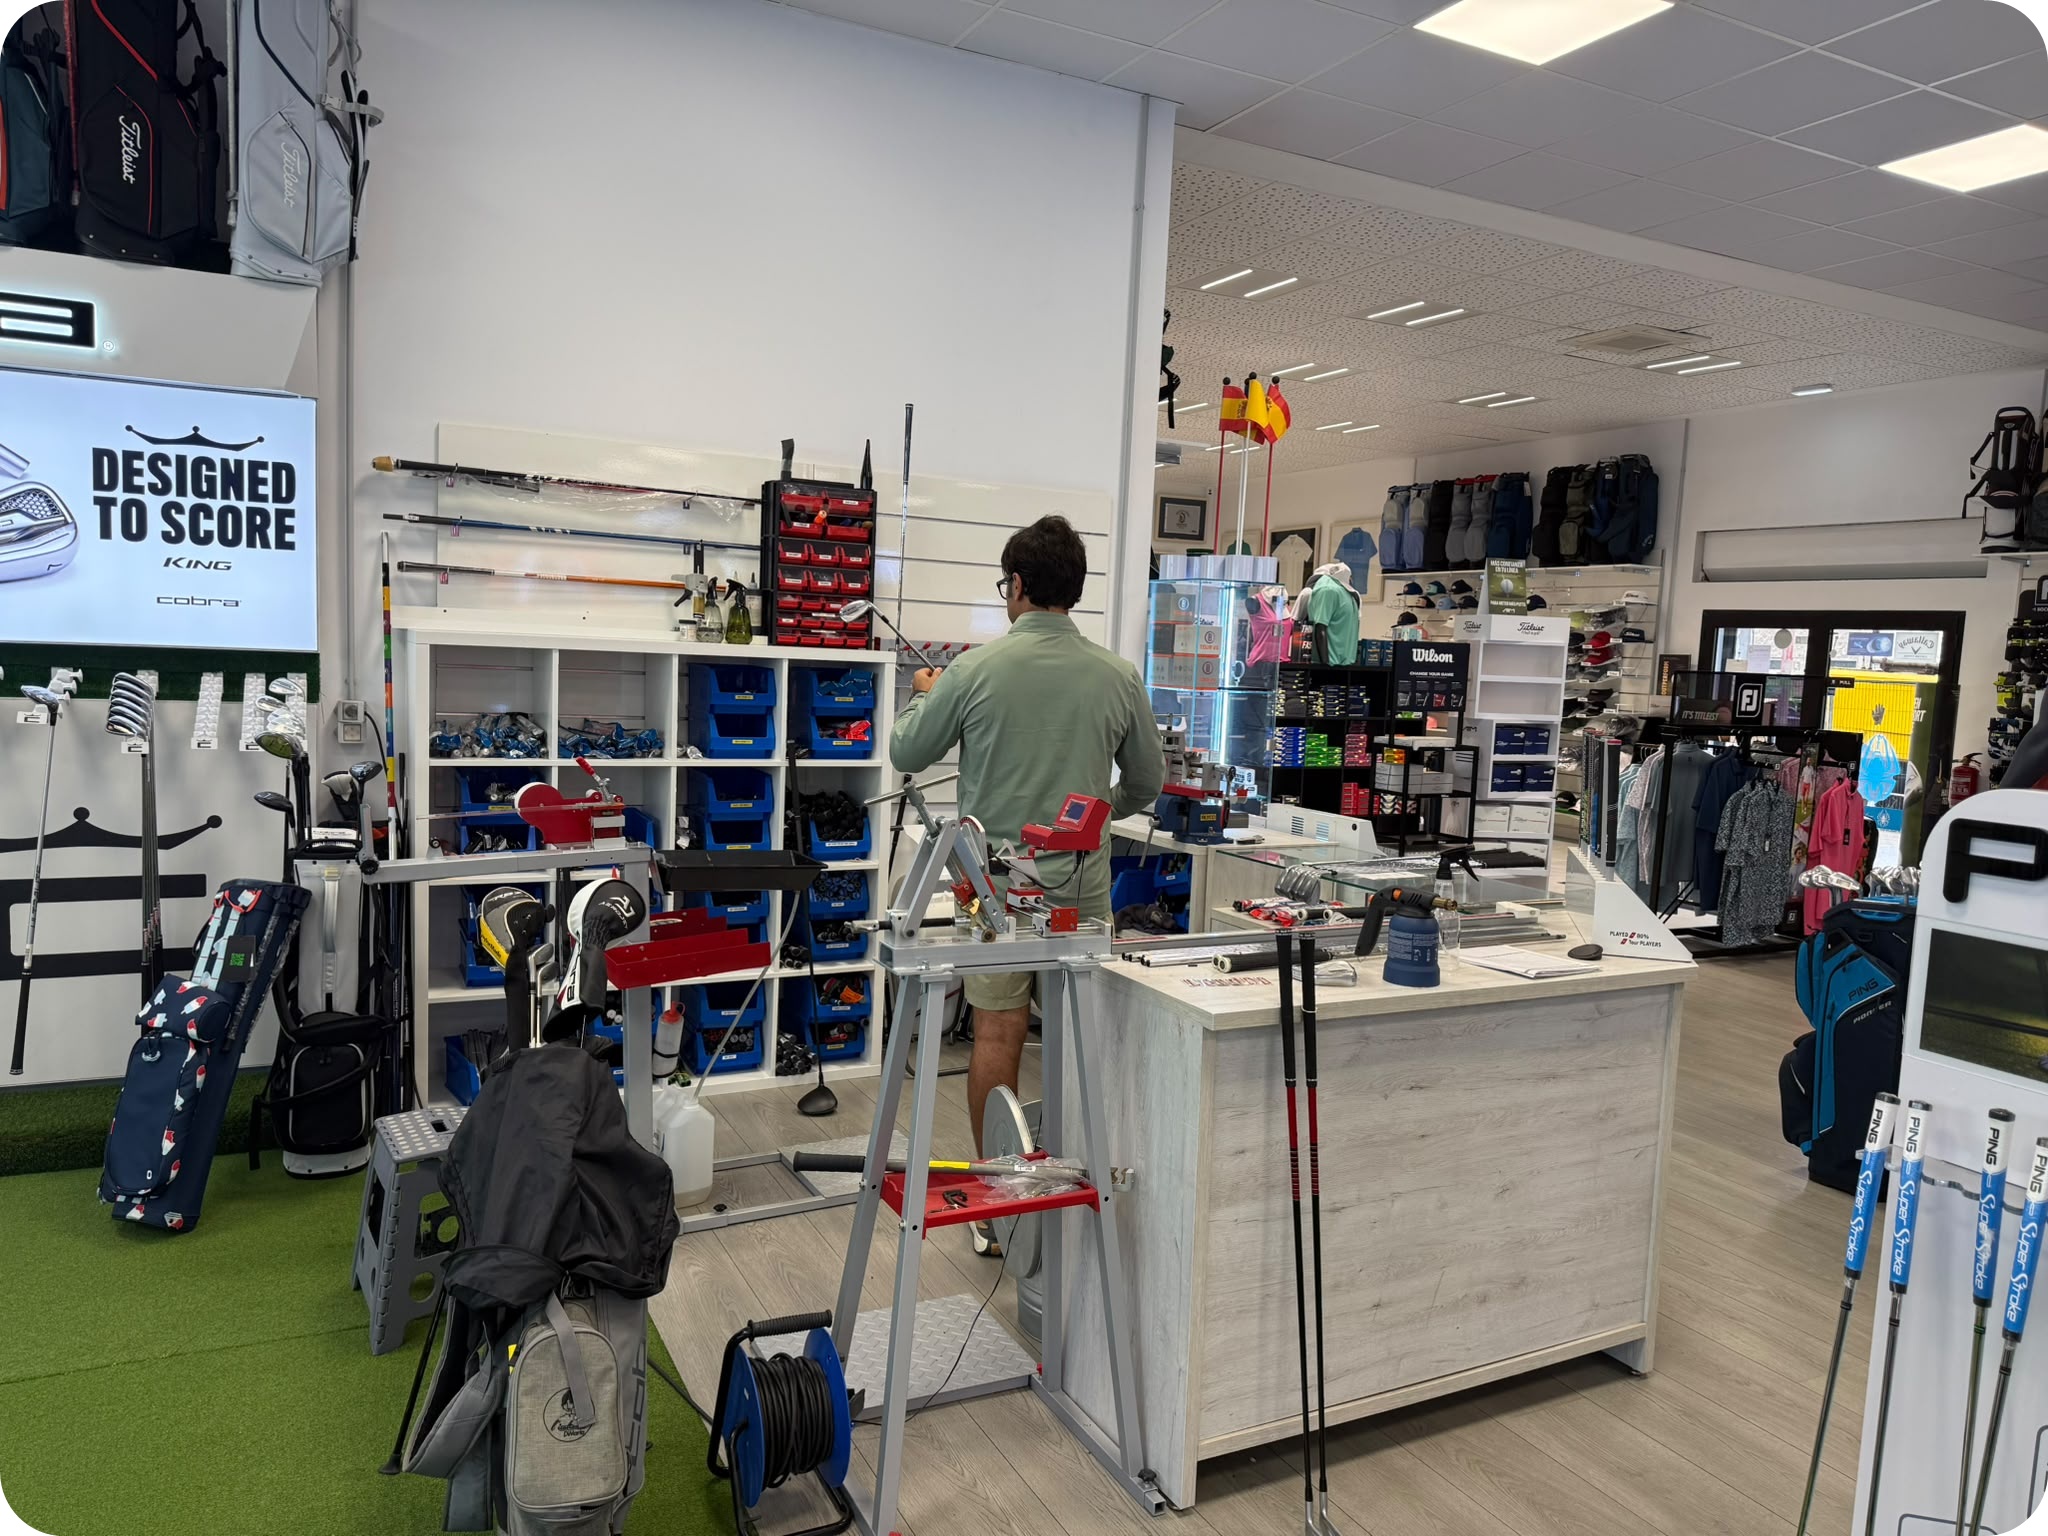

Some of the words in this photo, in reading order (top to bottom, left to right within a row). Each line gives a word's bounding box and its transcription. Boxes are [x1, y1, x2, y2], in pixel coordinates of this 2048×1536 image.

[118, 115, 141, 184] Titleist
[281, 141, 301, 208] Titleist
[92, 447, 297, 504] DESIGNED
[93, 495, 148, 542] TO
[160, 500, 296, 551] SCORE
[163, 557, 232, 571] KING
[156, 595, 241, 607] cobra
[1517, 621, 1545, 632] Titleist
[1411, 648, 1454, 663] Wilson
[1682, 710, 1693, 719] IT'S
[1694, 711, 1719, 720] TITLEIST
[1639, 940, 1661, 948] PLAYERS
[1848, 978, 1879, 1001] PING
[1868, 1108, 1883, 1144] PING
[1905, 1116, 1920, 1153] PING
[1986, 1126, 1999, 1166] PING
[2029, 1154, 2048, 1194] PING
